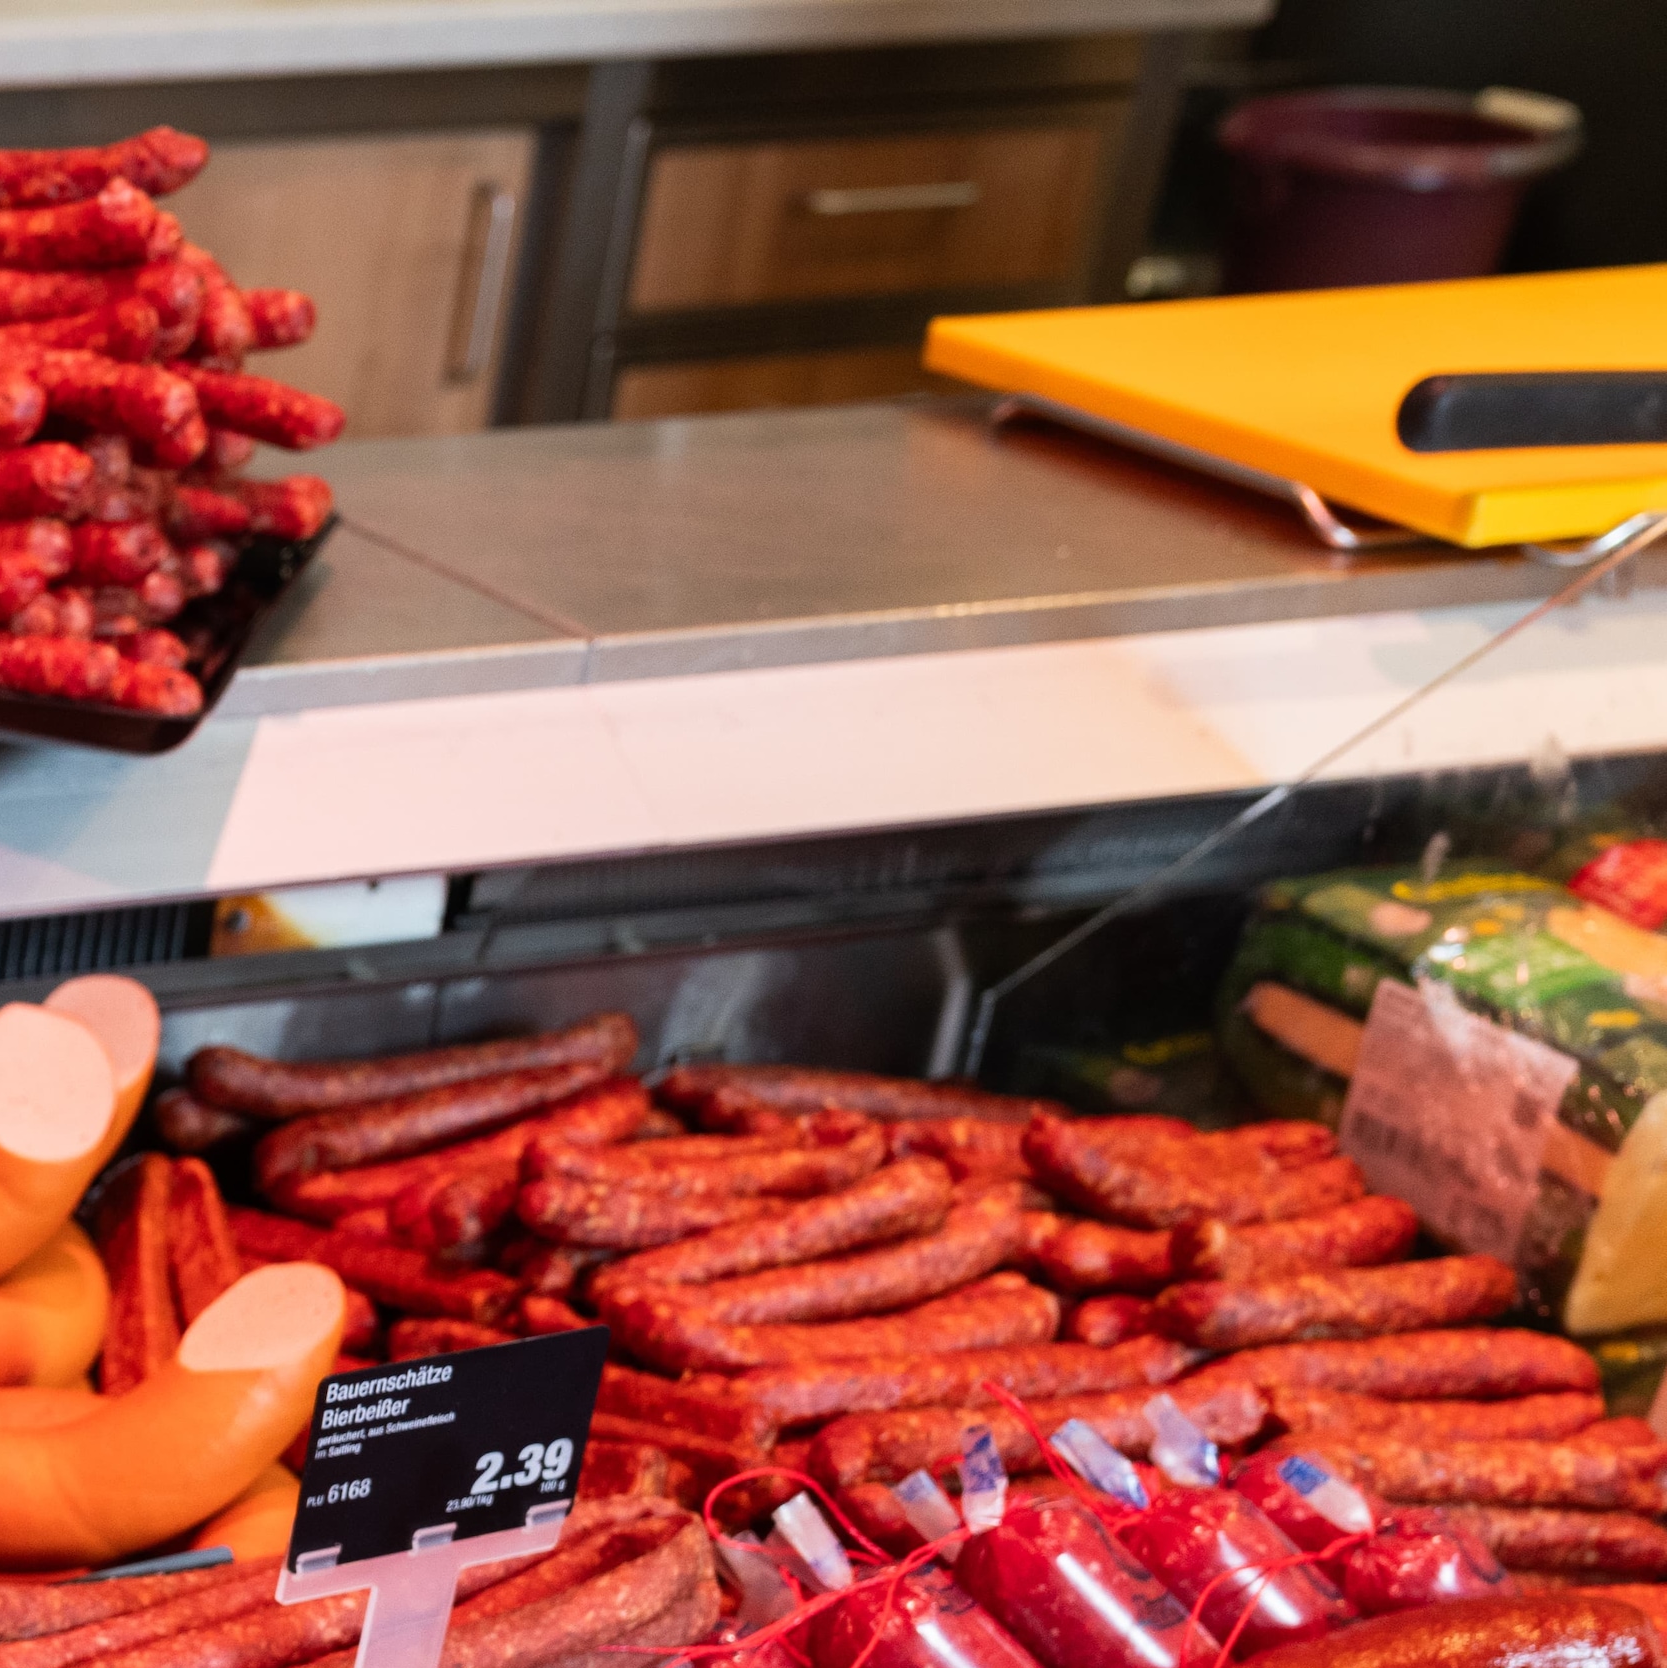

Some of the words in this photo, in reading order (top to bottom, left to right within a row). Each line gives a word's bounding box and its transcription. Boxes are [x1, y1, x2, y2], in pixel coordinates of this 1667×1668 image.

[326, 1365, 453, 1404] Bauernschätze
[321, 1398, 410, 1429] Bierbeißer
[470, 1437, 574, 1495] 2.39
[306, 1494, 325, 1508] PLU
[328, 1477, 372, 1504] 6168
